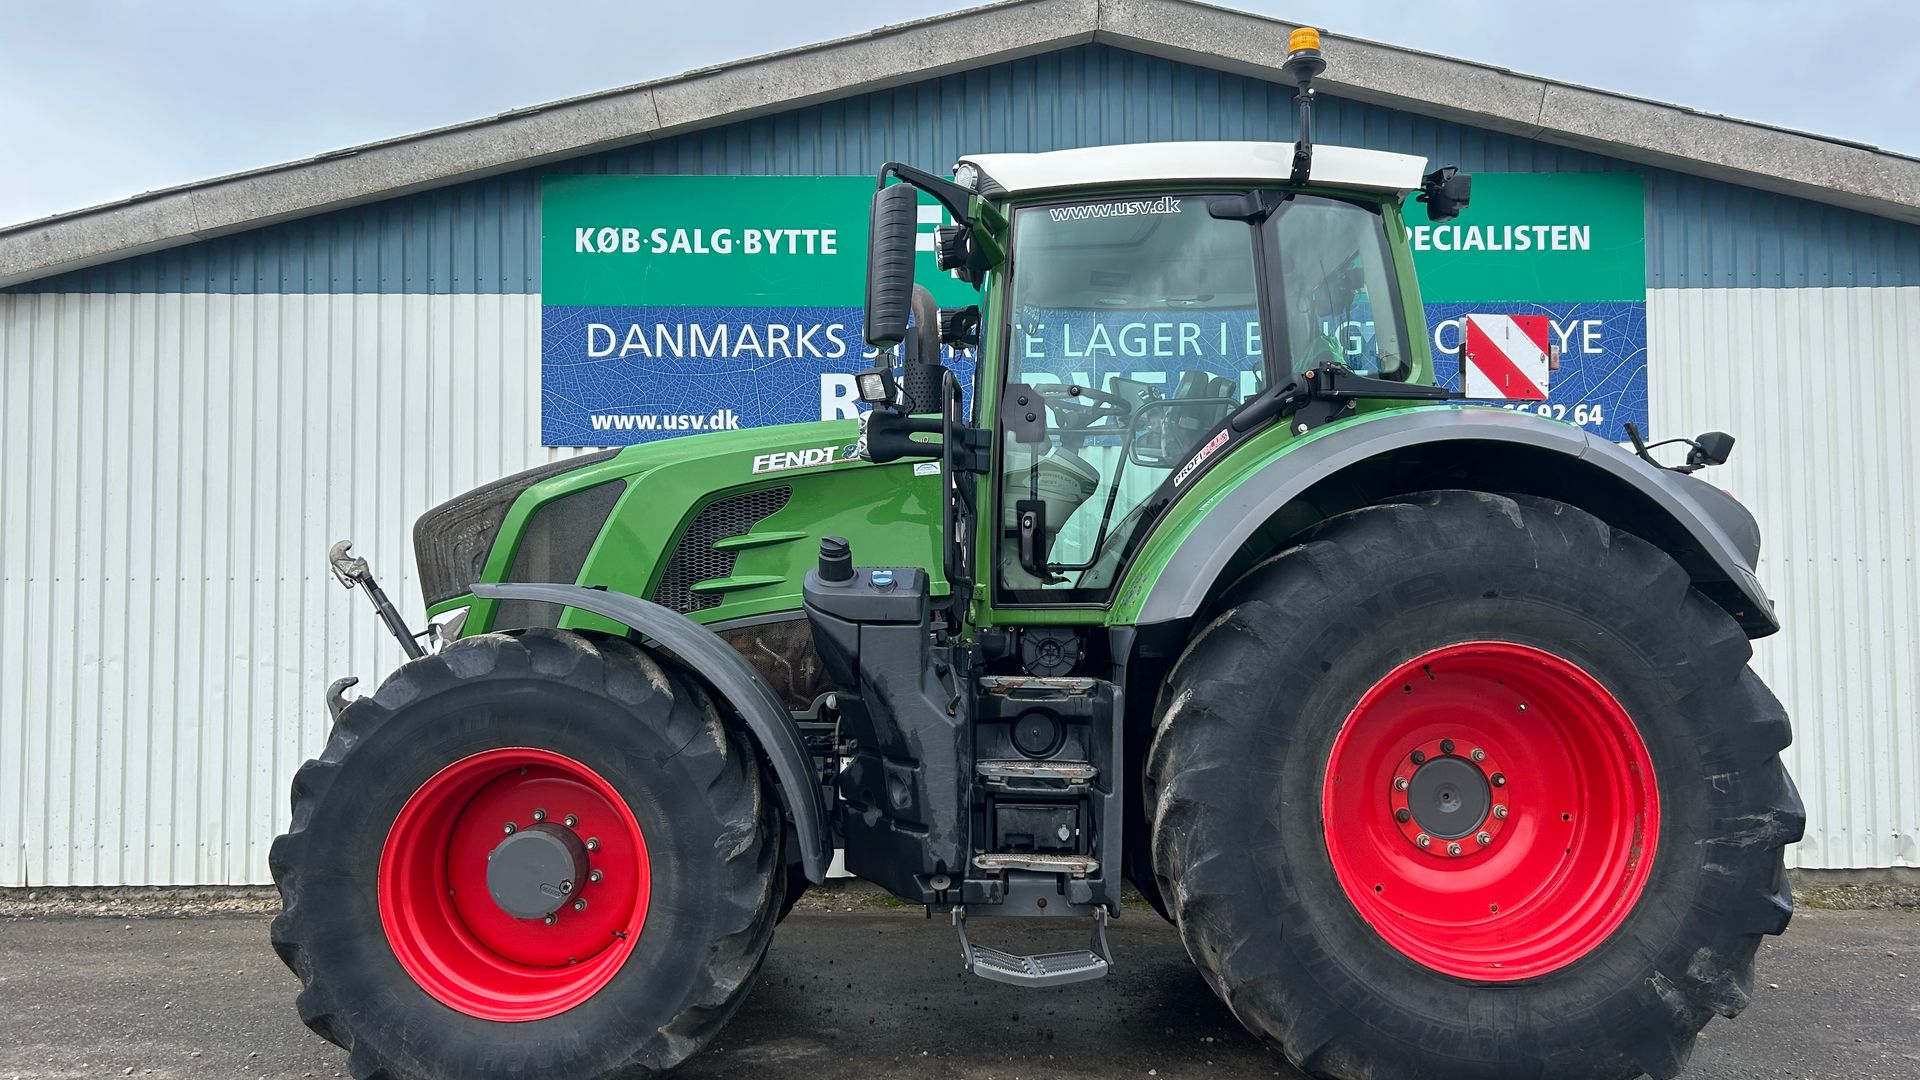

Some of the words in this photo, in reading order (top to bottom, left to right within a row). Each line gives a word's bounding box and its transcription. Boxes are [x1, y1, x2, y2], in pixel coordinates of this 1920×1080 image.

[1050, 197, 1181, 221] www.usv.dk
[588, 324, 845, 358] DANMARKS
[1064, 323, 1202, 357] LAGER
[1220, 323, 1227, 356] I
[591, 410, 739, 431] www.usv.dk
[1574, 404, 1603, 426] 64
[753, 446, 839, 473] FENDT
